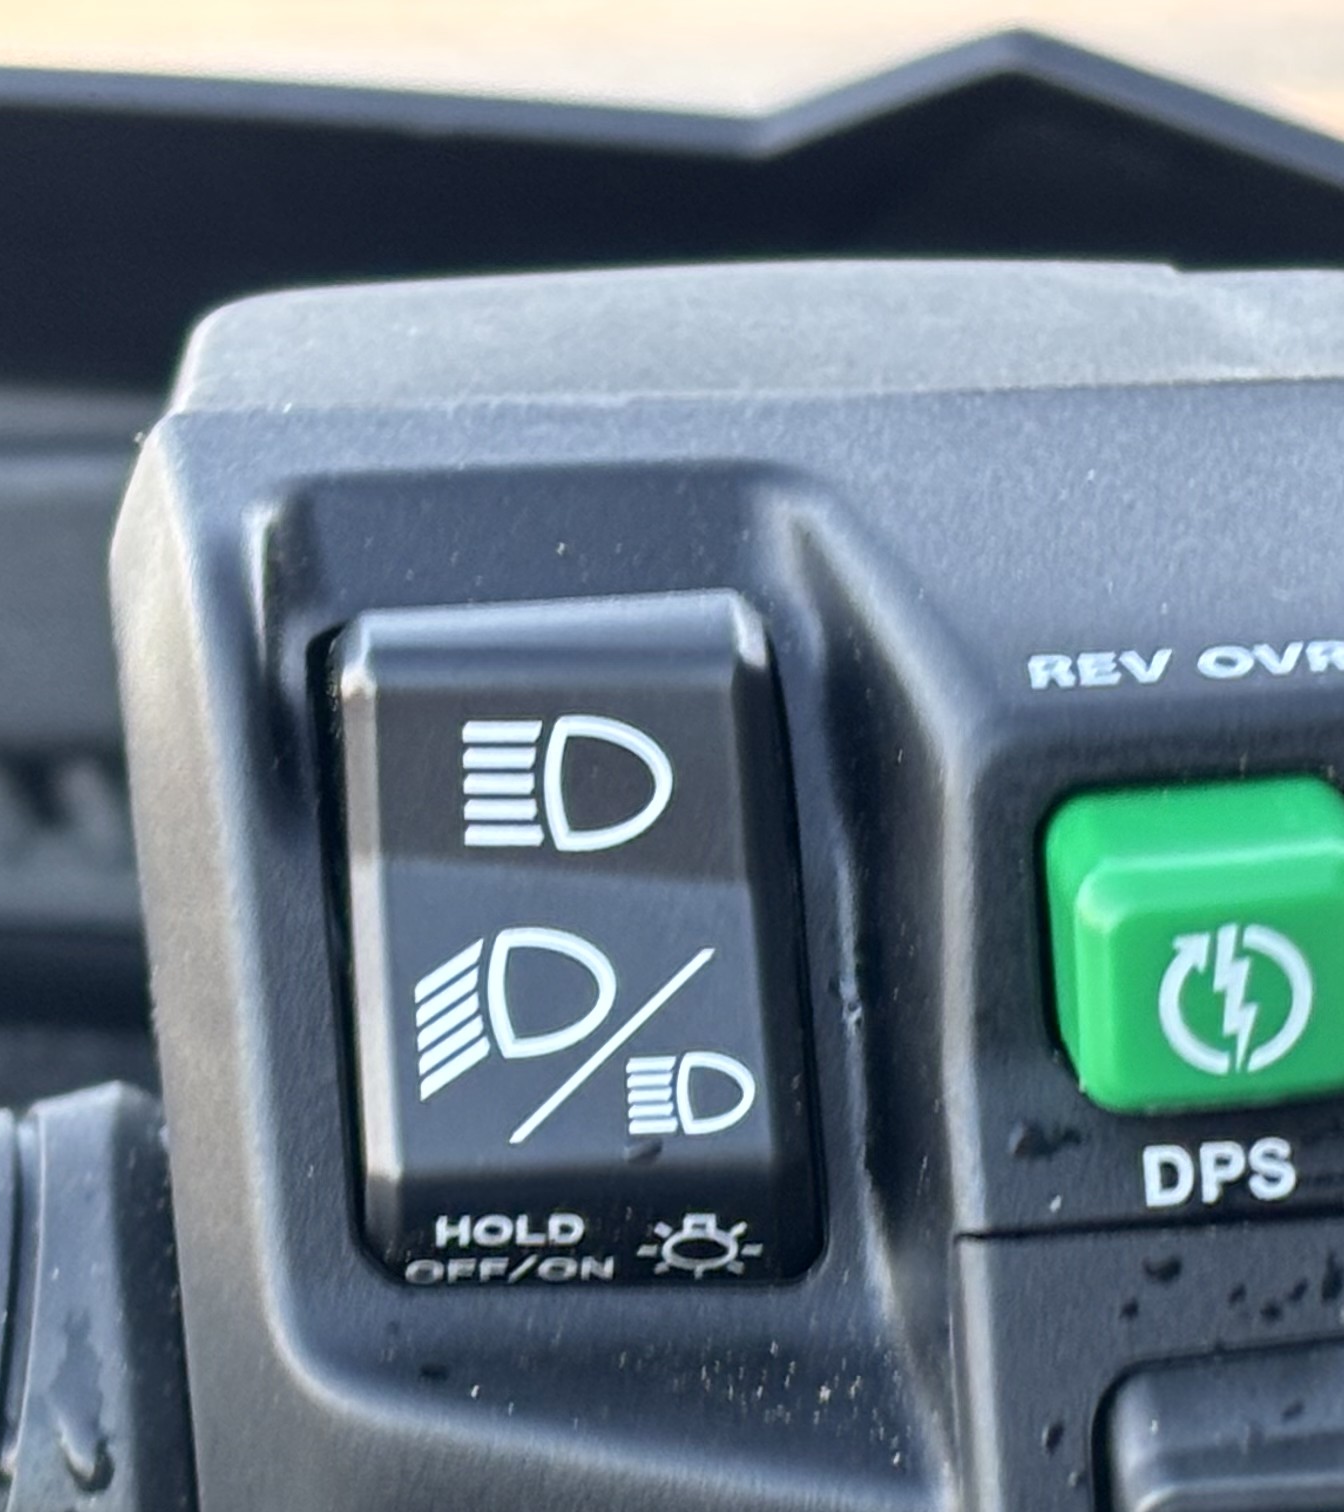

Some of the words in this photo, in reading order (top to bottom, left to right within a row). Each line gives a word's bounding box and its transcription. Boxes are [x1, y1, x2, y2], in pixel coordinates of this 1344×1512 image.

[1027, 648, 1173, 690] REV
[1142, 1135, 1297, 1208] DPS
[434, 1212, 586, 1249] HOLD
[404, 1253, 616, 1285] OFF/ON
